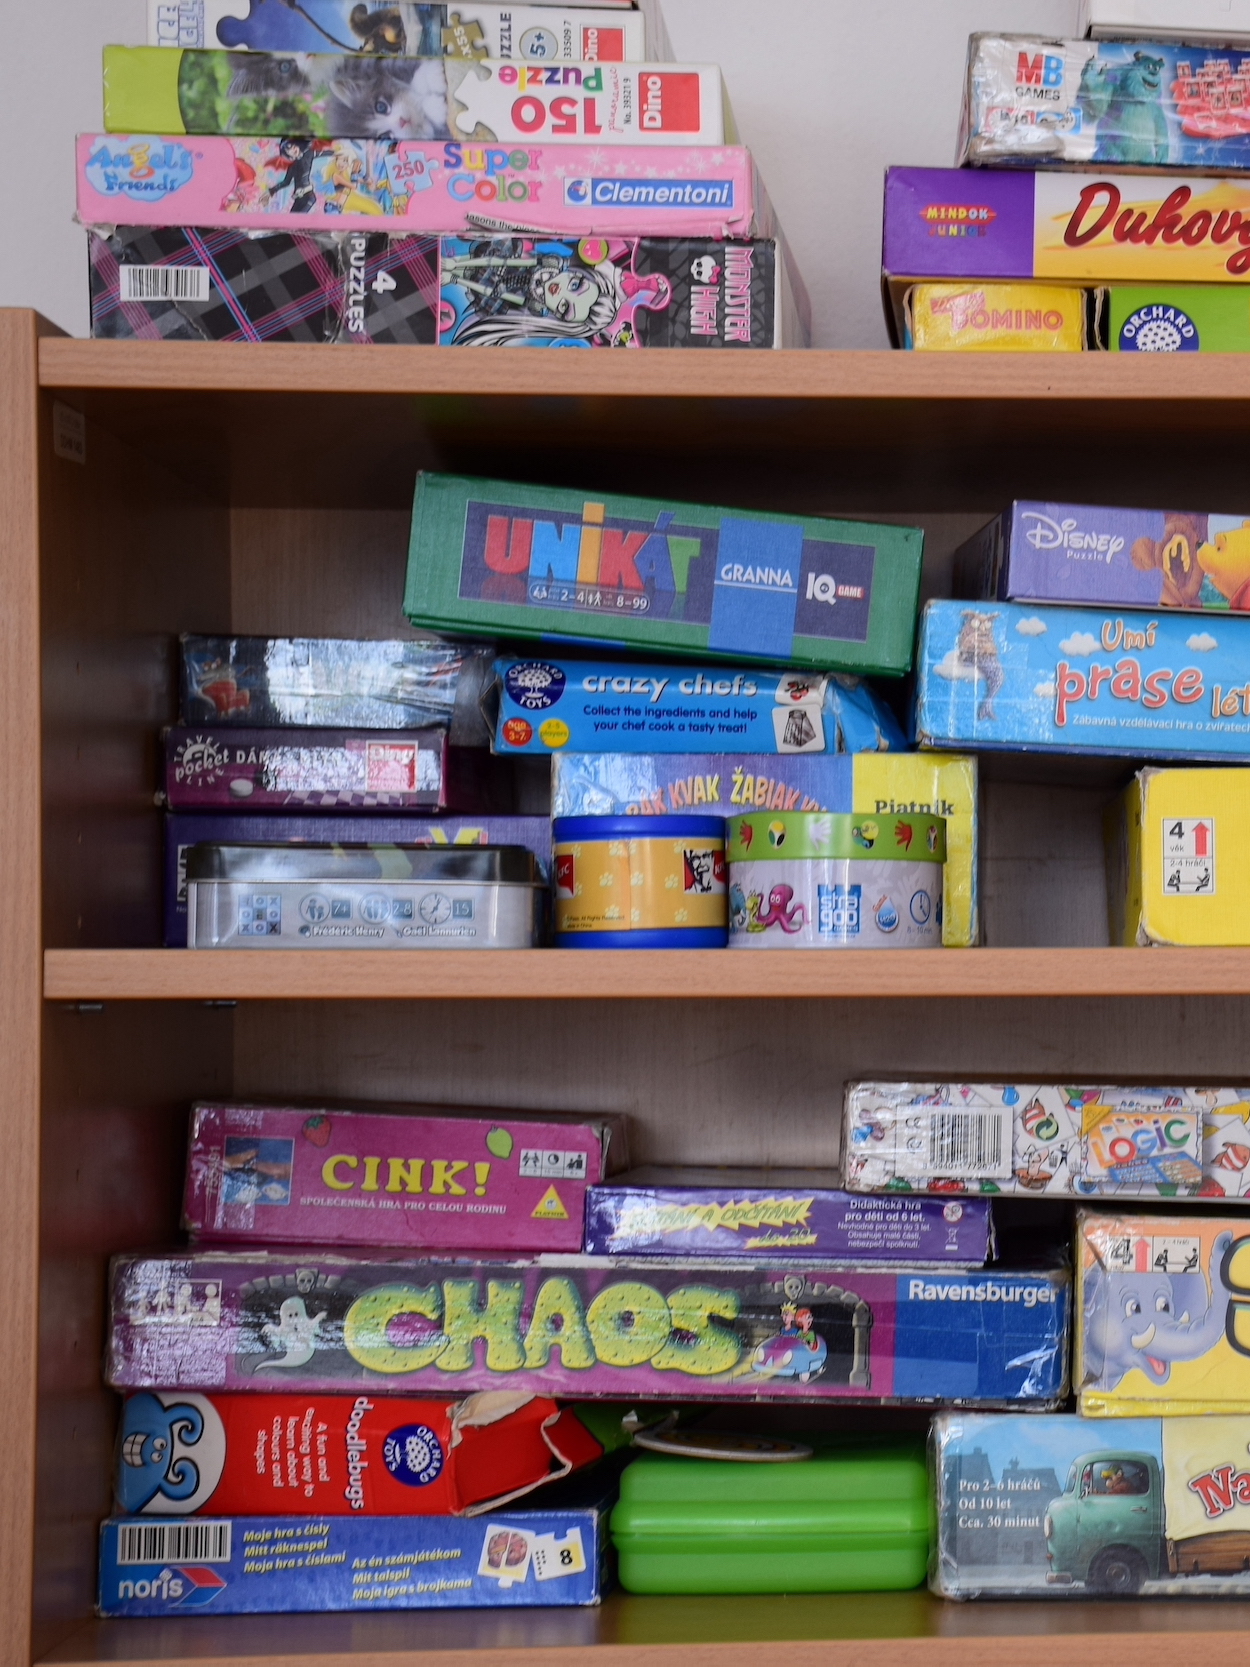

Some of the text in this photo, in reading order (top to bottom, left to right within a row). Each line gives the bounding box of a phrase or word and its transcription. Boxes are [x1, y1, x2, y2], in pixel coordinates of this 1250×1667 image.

[498, 65, 603, 93] Puzzle
[1016, 51, 1066, 88] MB
[643, 76, 662, 130] Dino
[1015, 87, 1060, 101] GAMES
[510, 96, 602, 135] 150
[86, 142, 193, 179] Angel's
[392, 160, 425, 180] 250
[443, 143, 543, 177] Super
[105, 172, 178, 194] Friends
[447, 174, 543, 202] Color
[594, 181, 729, 204] Clementoni
[925, 206, 988, 220] MINDOK
[927, 224, 988, 238] JUNIOR
[348, 238, 363, 333] PUZZLES
[372, 271, 396, 294] 4
[724, 246, 754, 343] MONSTER
[690, 285, 721, 336] HIGH
[1122, 304, 1195, 339] ORCHARD
[1066, 549, 1104, 562] Puzzle
[720, 562, 794, 588] GRANNA
[806, 573, 836, 606] IQ
[838, 584, 863, 599] GAME
[1101, 620, 1159, 650] Umí
[519, 695, 551, 709] TOYS
[582, 673, 758, 703] crazy chefs
[1054, 658, 1205, 727] prase
[583, 704, 758, 724] Collect the ingredients and help
[594, 718, 747, 737] your chef cook a tasty treat!
[175, 747, 230, 784] pocket
[669, 774, 720, 808] KVAK
[730, 766, 802, 812] ŽABIAK
[1169, 822, 1184, 839] 4
[321, 1154, 491, 1197] CINK!
[300, 1194, 507, 1215] SPOLEČENSKÁ HRA PRO CELOU RODINU
[849, 1198, 922, 1210] Didaktická hra
[907, 1279, 1059, 1308] Ravensburger
[343, 1275, 743, 1375] CHAOS
[254, 1429, 267, 1474] shapes
[345, 1396, 373, 1511] doodlebugs
[383, 1437, 398, 1472] TOYS
[416, 1425, 441, 1483] ORCHARD
[958, 1478, 980, 1492] Pro
[1007, 1477, 1042, 1492] hráčů
[958, 1496, 1012, 1510] Od 10 let
[958, 1514, 1040, 1528] Cca. 30 minut
[559, 1549, 573, 1566] 8
[118, 1569, 183, 1600] noris
